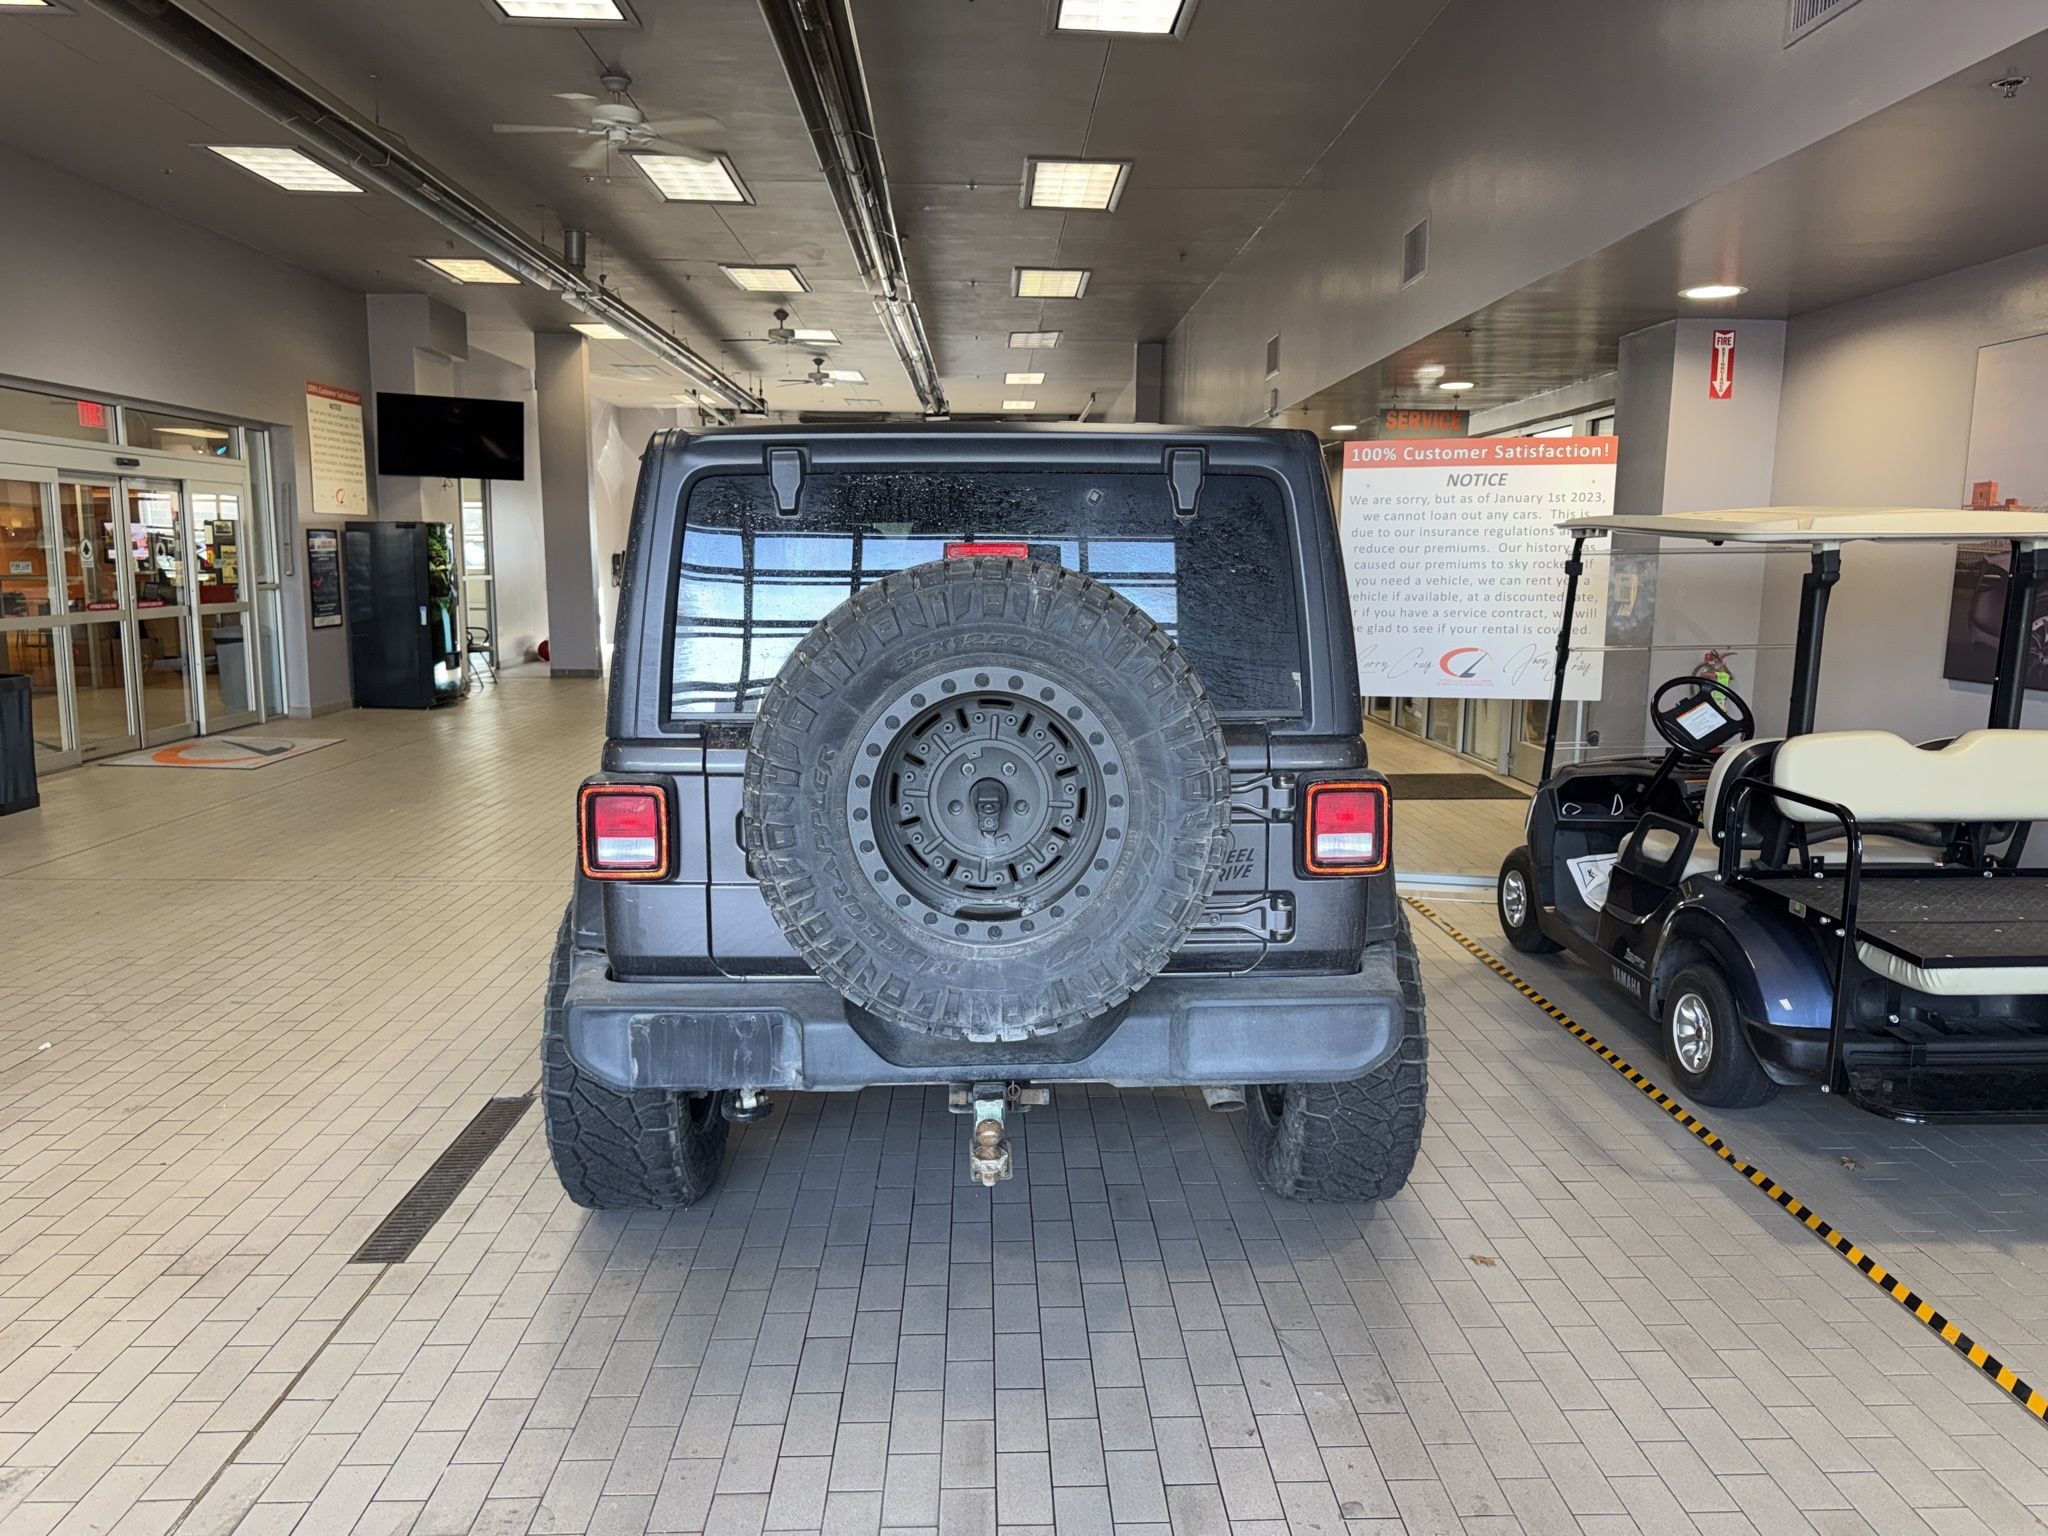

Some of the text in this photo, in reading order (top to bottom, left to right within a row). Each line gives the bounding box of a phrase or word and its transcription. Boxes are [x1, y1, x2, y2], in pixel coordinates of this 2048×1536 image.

[1716, 336, 1732, 346] FIRE
[1385, 410, 1463, 431] SERVICE
[1351, 442, 1610, 462] 100% Customer Satisfaction!
[1445, 472, 1509, 487] NOTICE
[1349, 492, 1606, 507] We are sorry, but as of January 1st 2023,
[1362, 508, 1591, 522] we cannot loan out any cars. This is
[1351, 527, 1374, 538] due
[1378, 528, 1391, 538] to
[1394, 529, 1415, 538] our
[1419, 527, 1480, 537] insurance
[1483, 526, 1555, 539] regulations
[1353, 542, 1597, 555] reduce our premiums. Our history as
[1353, 558, 1595, 571] caused our premiums to sky rocke If
[1355, 577, 1377, 588] you
[1380, 575, 1411, 586] need
[1414, 577, 1422, 586] a
[1425, 575, 1473, 587] vehicle,
[1477, 577, 1496, 586] we
[1499, 577, 1521, 586] can
[1525, 576, 1552, 586] rent
[1583, 577, 1591, 586] a
[1350, 591, 1598, 603] ehicle if available, at a discounted ate,
[1362, 607, 1370, 617] if
[1374, 609, 1396, 619] you
[1400, 607, 1428, 618] have
[1432, 609, 1439, 617] a
[1443, 608, 1488, 618] service
[1491, 608, 1548, 619] contract,
[1575, 607, 1598, 618] will
[1353, 623, 1592, 635] e glad to see if your rental is coved.
[1223, 848, 1255, 864] EEL
[1219, 864, 1254, 882] RIVE
[1611, 964, 1642, 998] YAMAHA
